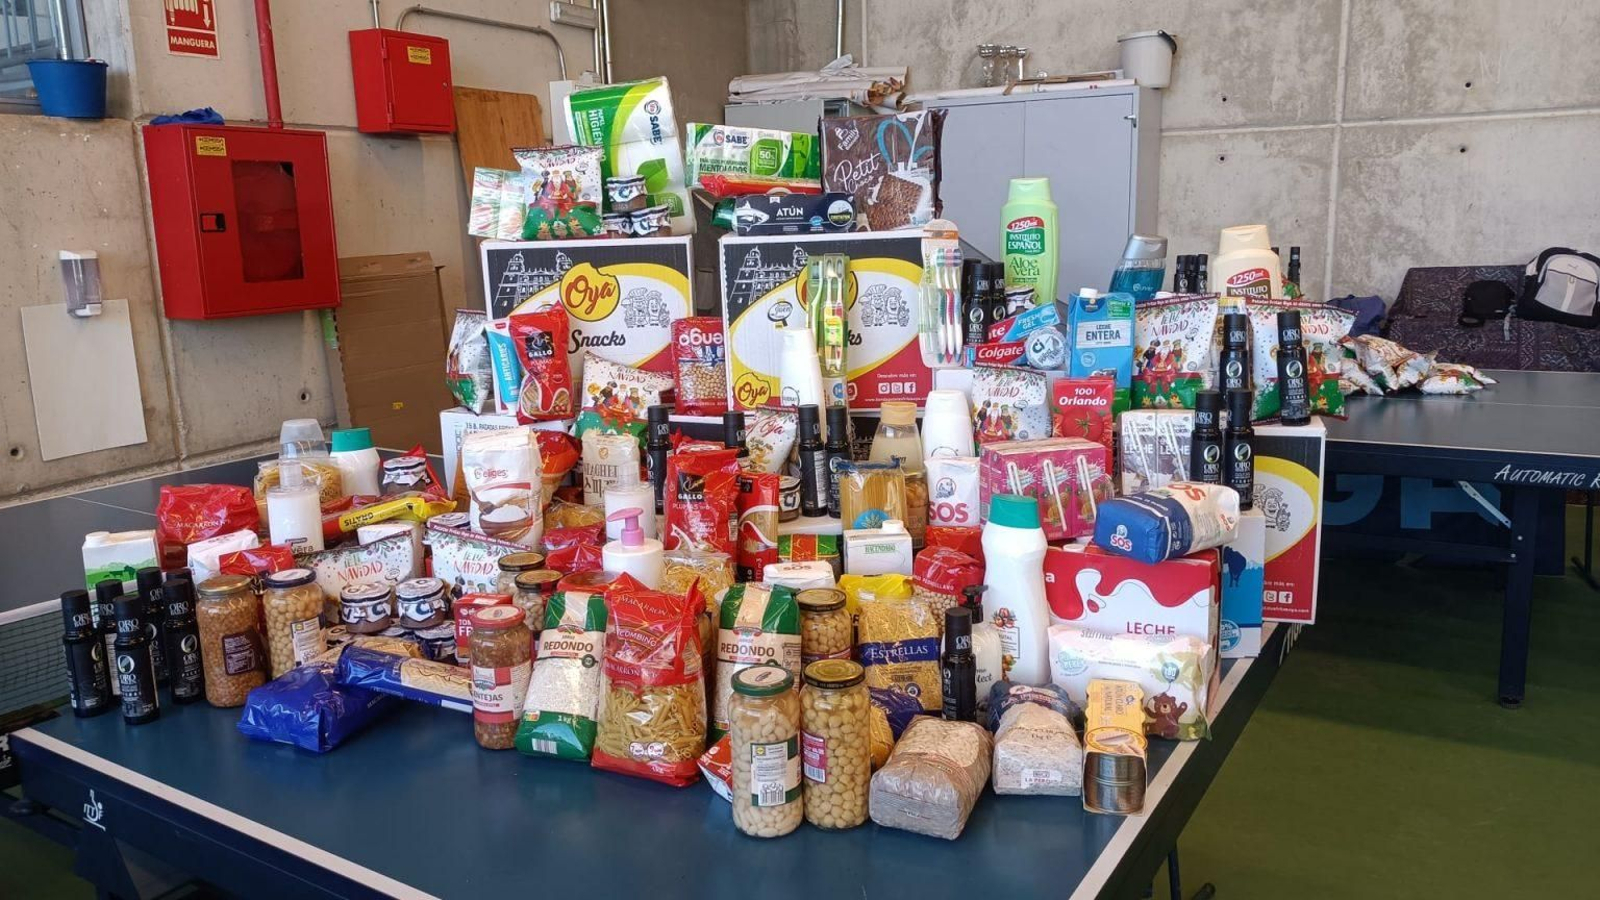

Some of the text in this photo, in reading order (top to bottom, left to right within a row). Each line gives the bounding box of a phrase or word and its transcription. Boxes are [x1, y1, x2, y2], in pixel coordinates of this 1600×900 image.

[170, 35, 216, 50] MANGUERA
[649, 115, 662, 145] SABE
[725, 133, 749, 146] SABE
[833, 152, 882, 191] Petit
[776, 205, 804, 217] ATÚN
[1009, 233, 1041, 241] INSTITUTO
[1008, 240, 1042, 251] ESPAÑOL
[1009, 257, 1038, 270] Aloe
[1012, 265, 1040, 277] Vera
[565, 275, 617, 316] Oya
[1230, 284, 1267, 296] INSTITUTO
[568, 329, 627, 354] Snacks
[678, 329, 725, 347] engo
[1085, 329, 1121, 341] ENTERA
[528, 349, 553, 358] GALLO
[978, 345, 1024, 361] Colgate
[737, 382, 769, 406] Oya
[1059, 395, 1107, 406] Orlando
[1494, 463, 1586, 486] AUTOMATIC
[1167, 483, 1207, 501] OS
[343, 511, 375, 527] GRATIS
[929, 502, 969, 523] SOS
[1111, 532, 1133, 550] SOS
[1126, 621, 1176, 635] LECHE
[620, 630, 657, 647] COMBINO
[543, 640, 594, 653] REDONDO
[720, 642, 775, 657] REDONDO
[870, 645, 928, 660] ESTRELLAS
